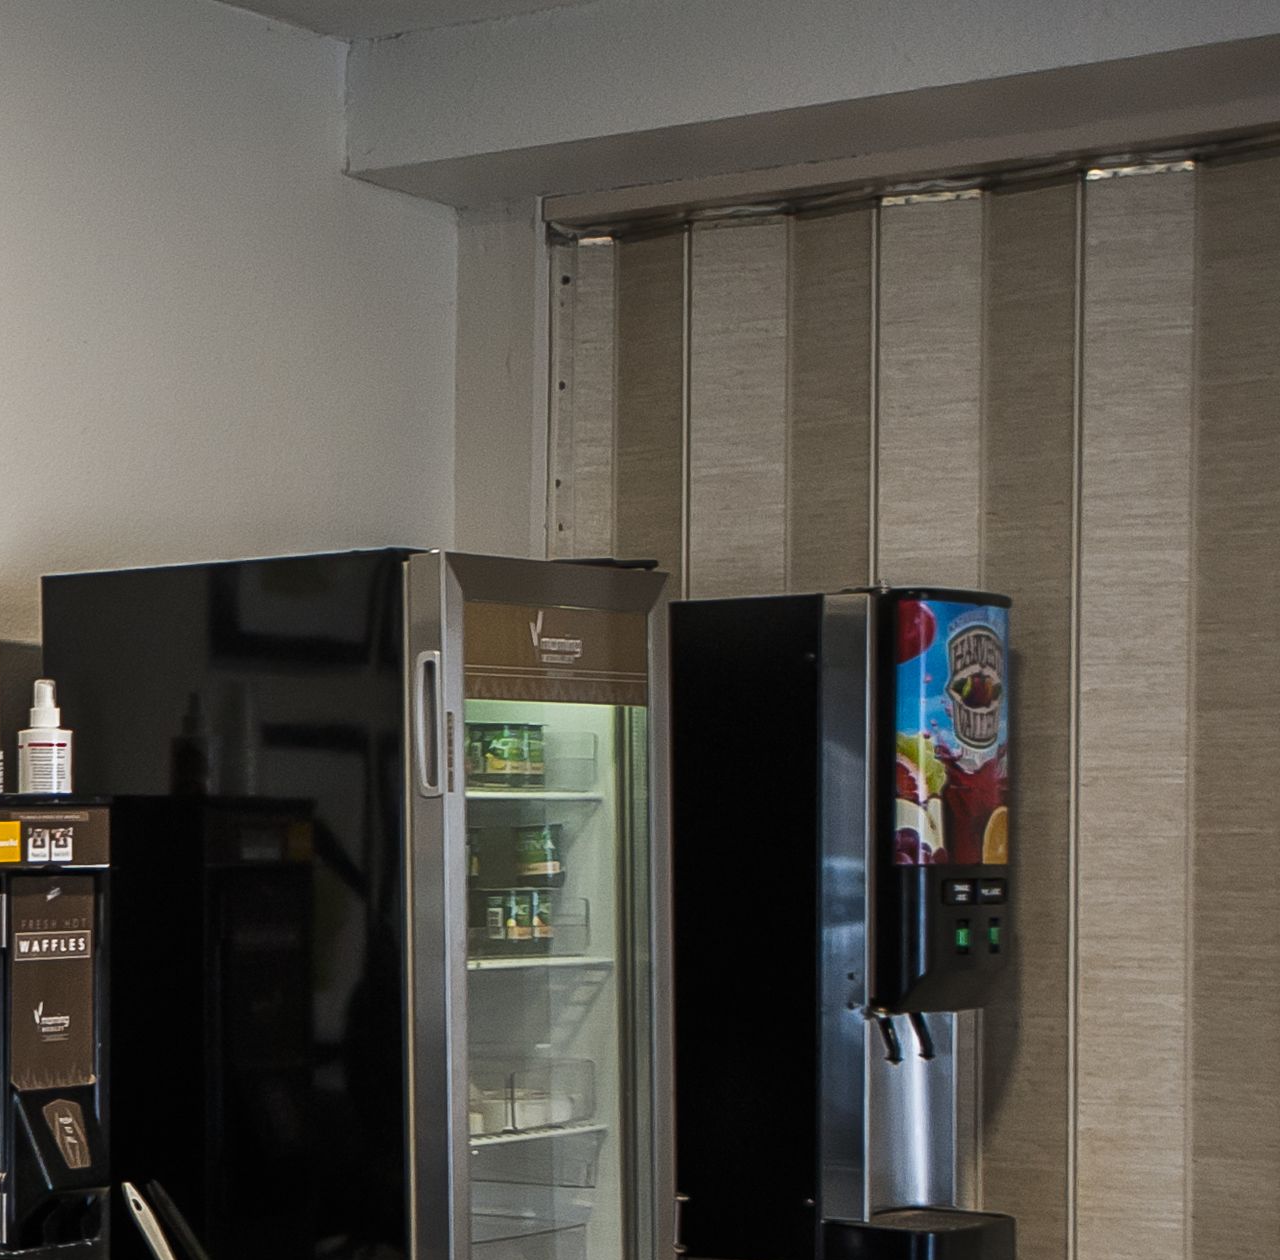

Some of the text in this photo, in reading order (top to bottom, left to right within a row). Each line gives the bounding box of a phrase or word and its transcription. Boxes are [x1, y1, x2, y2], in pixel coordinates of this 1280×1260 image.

[21, 917, 88, 930] FRESH HOT
[19, 937, 86, 953] WAFFLES
